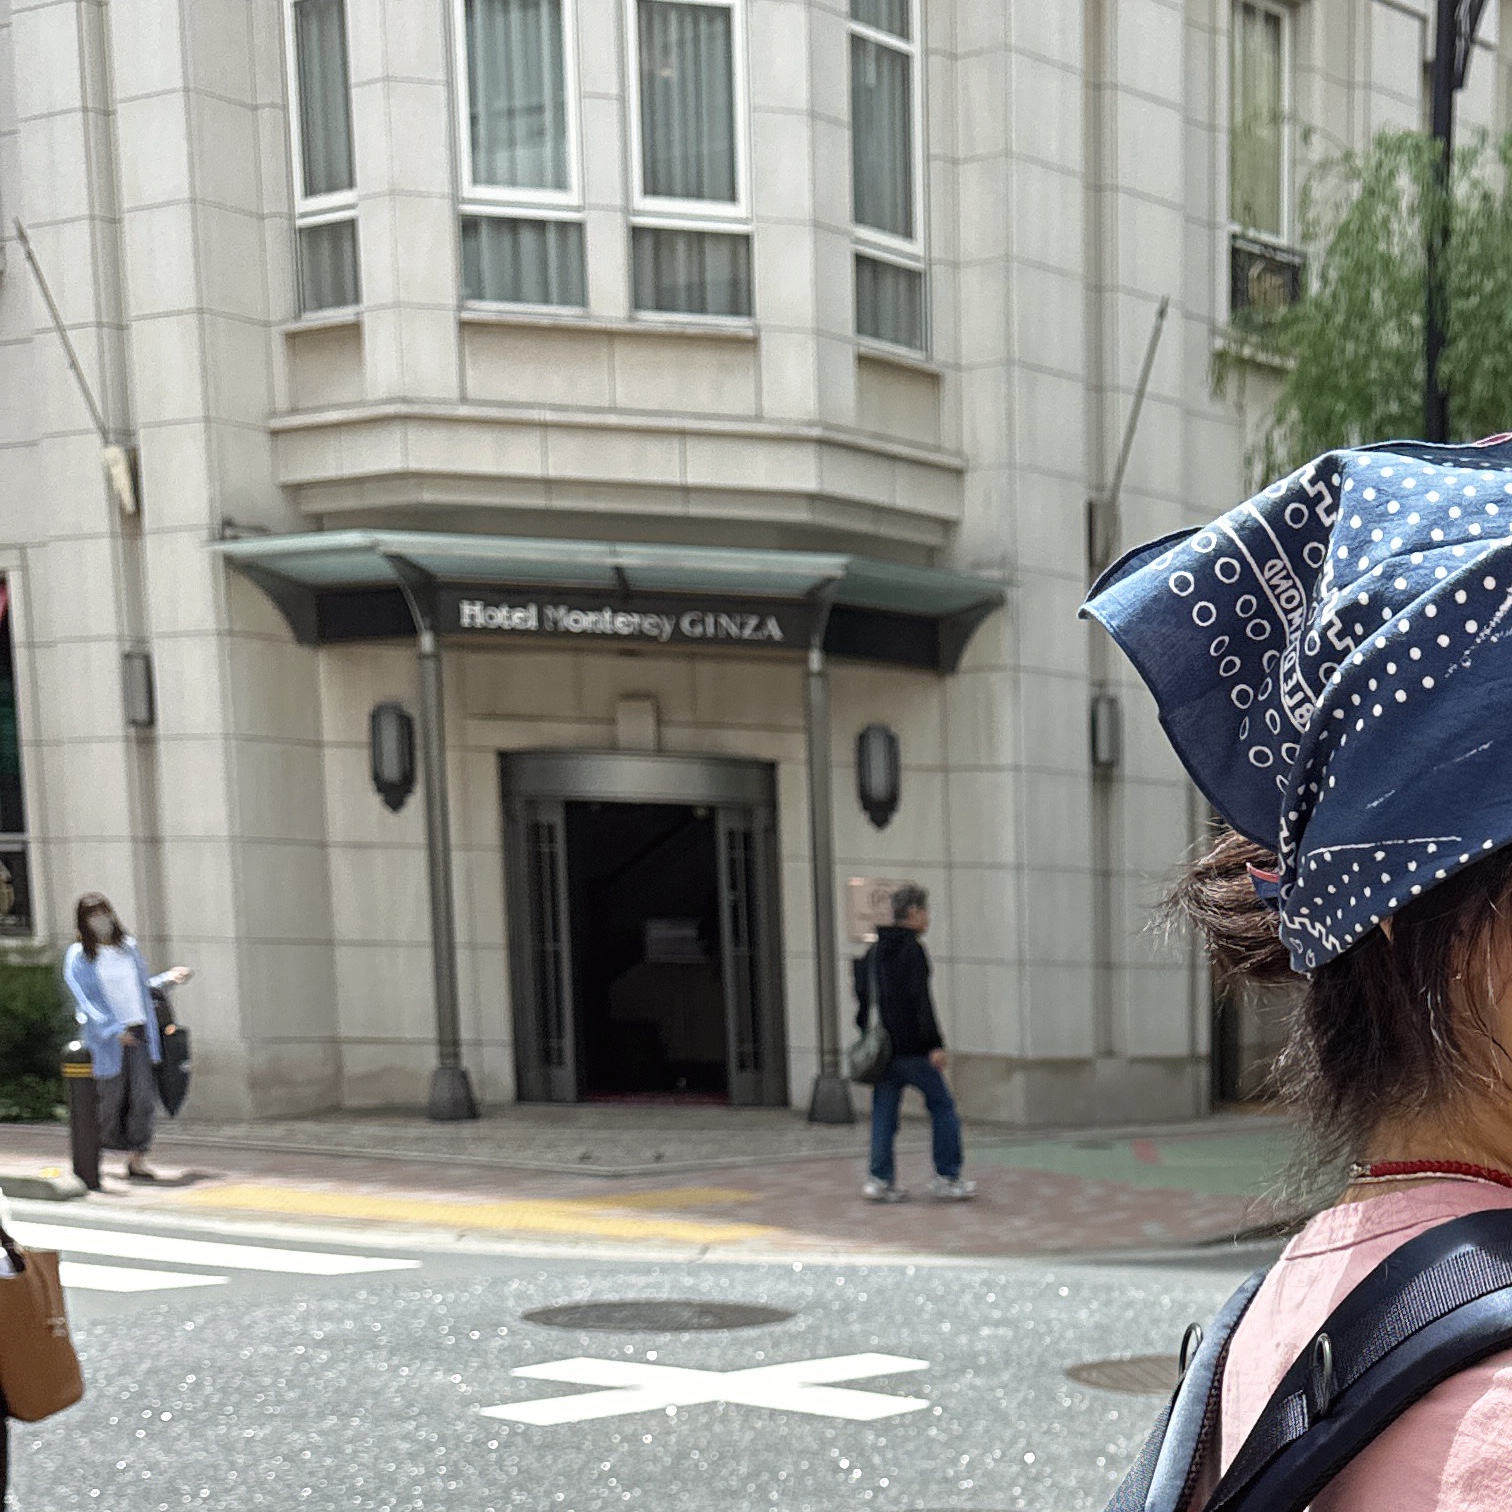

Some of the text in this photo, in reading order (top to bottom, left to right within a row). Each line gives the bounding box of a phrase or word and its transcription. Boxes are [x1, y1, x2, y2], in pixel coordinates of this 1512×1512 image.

[459, 600, 784, 642] Hotel Monterey GINZA
